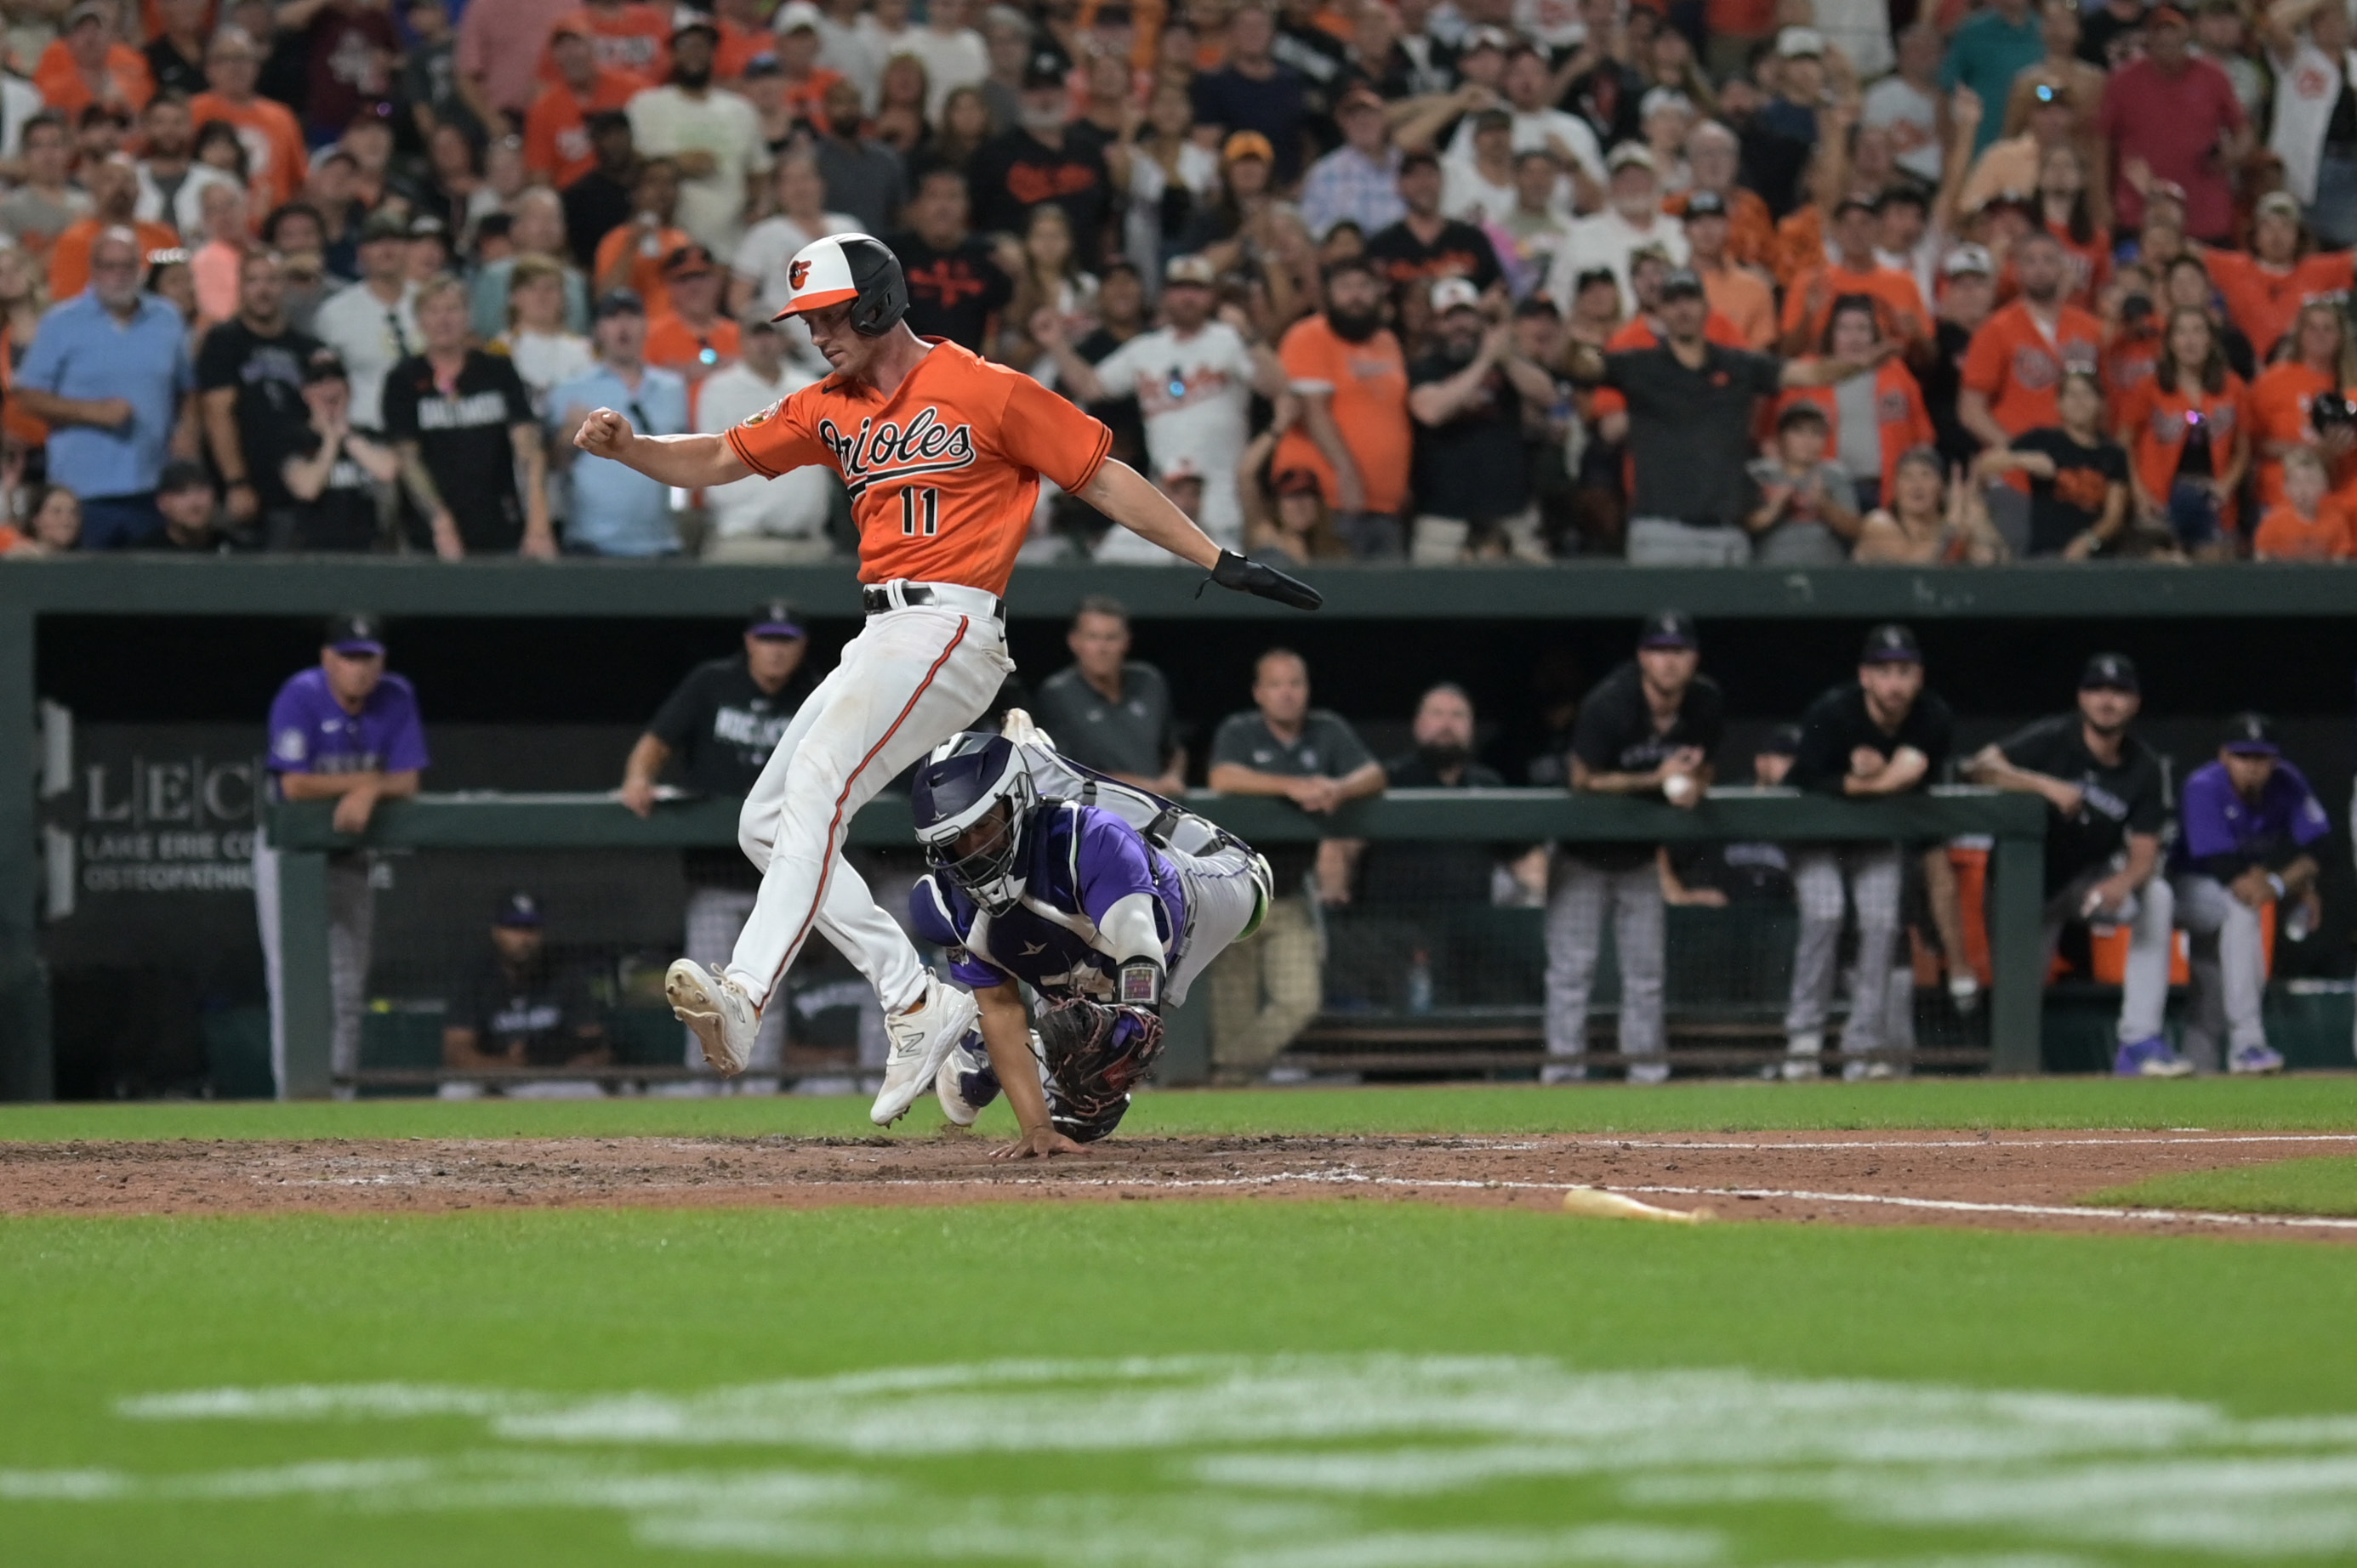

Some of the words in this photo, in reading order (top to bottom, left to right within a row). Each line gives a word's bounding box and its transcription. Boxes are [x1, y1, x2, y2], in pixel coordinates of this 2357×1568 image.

[818, 406, 976, 480] Orioles
[900, 486, 938, 537] 11
[84, 832, 151, 860] LAKE
[157, 832, 216, 860] ERIE
